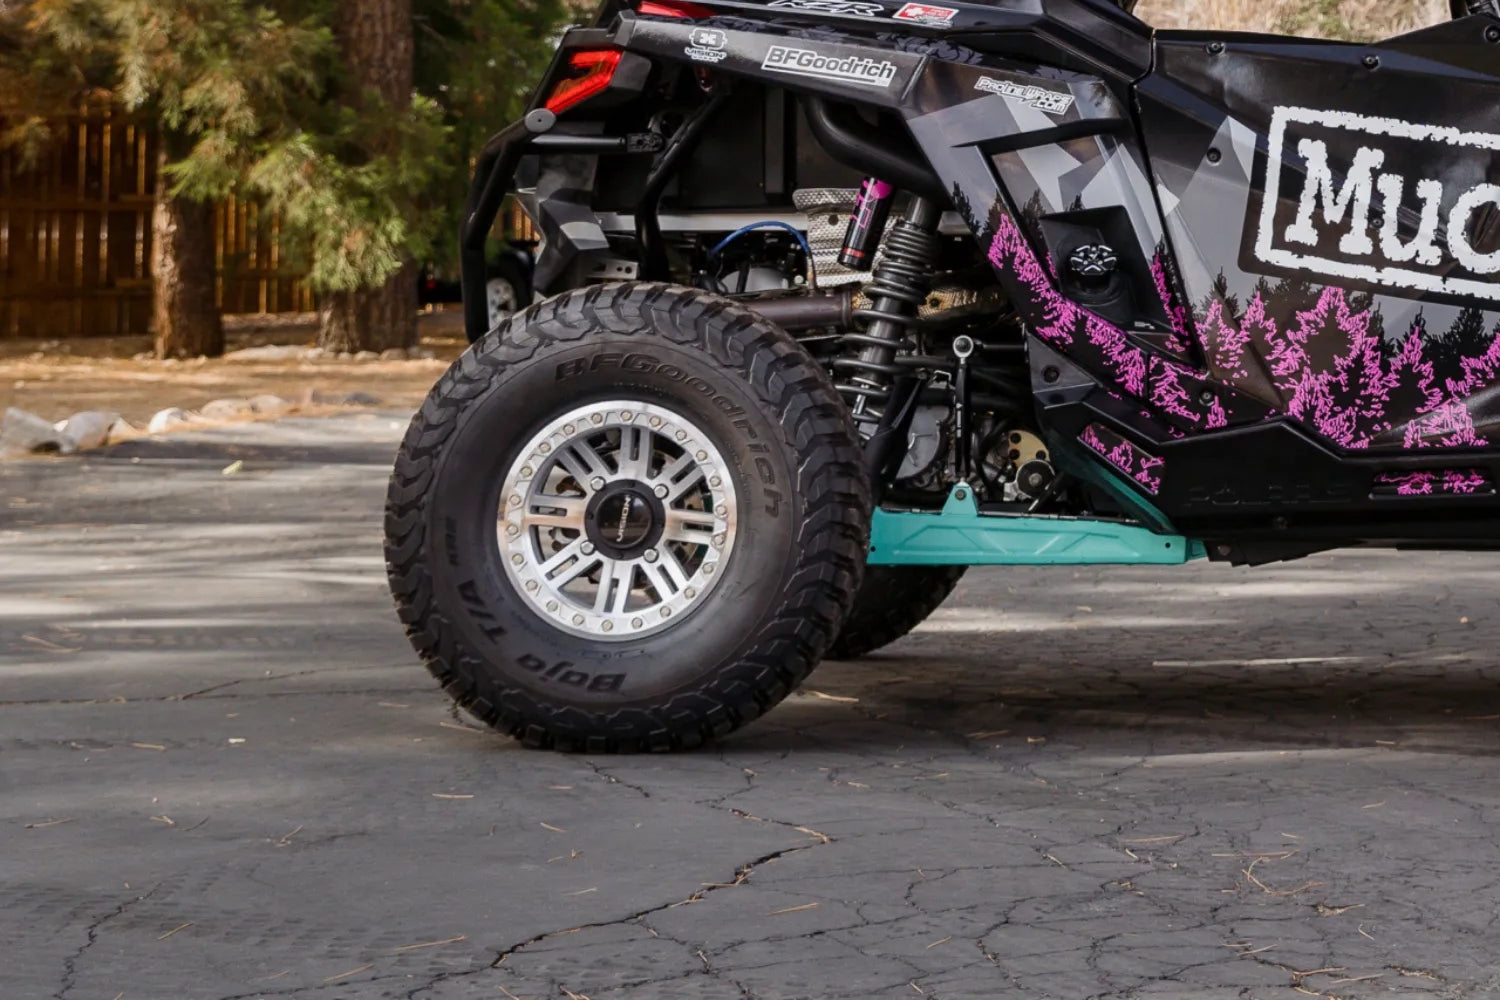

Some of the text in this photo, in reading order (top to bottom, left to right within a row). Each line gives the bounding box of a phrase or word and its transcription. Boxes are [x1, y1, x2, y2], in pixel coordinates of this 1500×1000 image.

[685, 48, 726, 59] VISION
[767, 47, 894, 79] BFGoodrich
[555, 353, 783, 518] BFGoodrich
[457, 579, 508, 645] T/A
[514, 653, 627, 692] Baja
